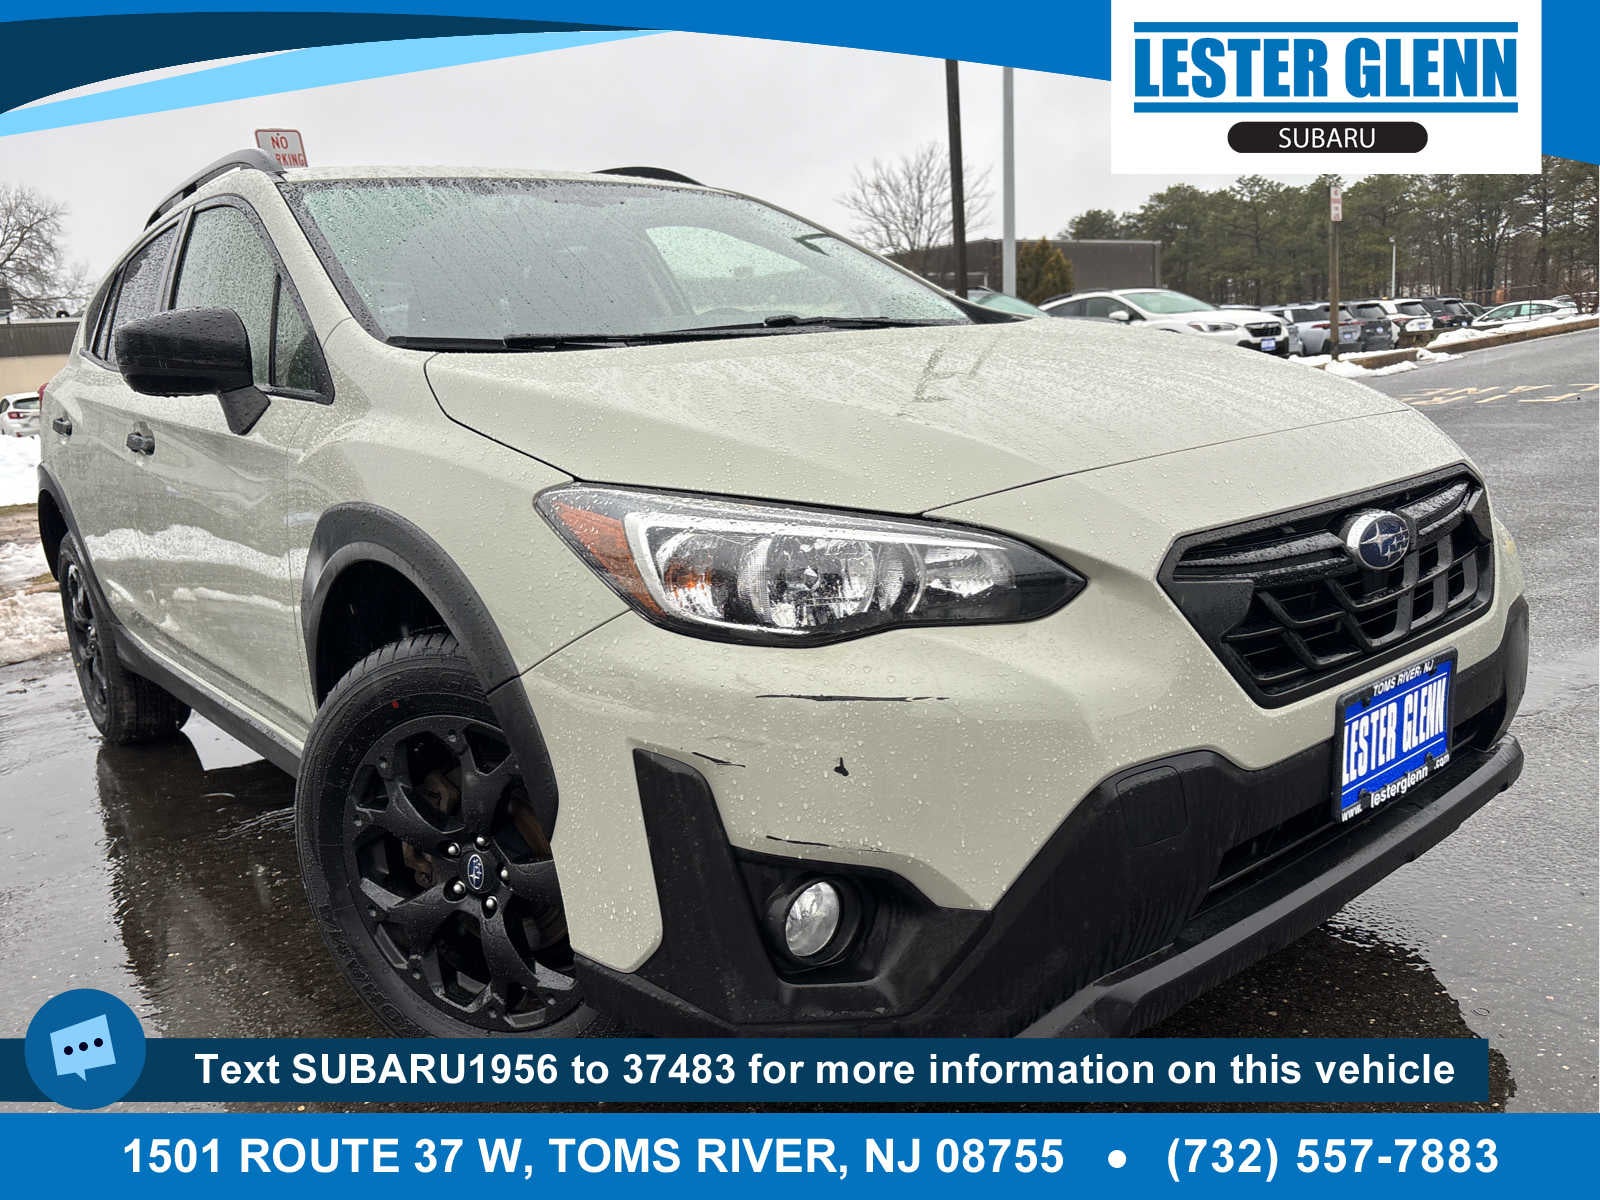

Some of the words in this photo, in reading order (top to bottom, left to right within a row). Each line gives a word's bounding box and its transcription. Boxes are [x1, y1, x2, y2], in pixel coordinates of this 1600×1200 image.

[271, 136, 289, 149] NO
[275, 153, 305, 167] RKING
[1373, 677, 1396, 696] TOMS
[1398, 667, 1423, 686] RIVER,
[1423, 659, 1435, 675] NJ
[1342, 701, 1398, 787] LESTER
[1402, 677, 1447, 753] GLENN
